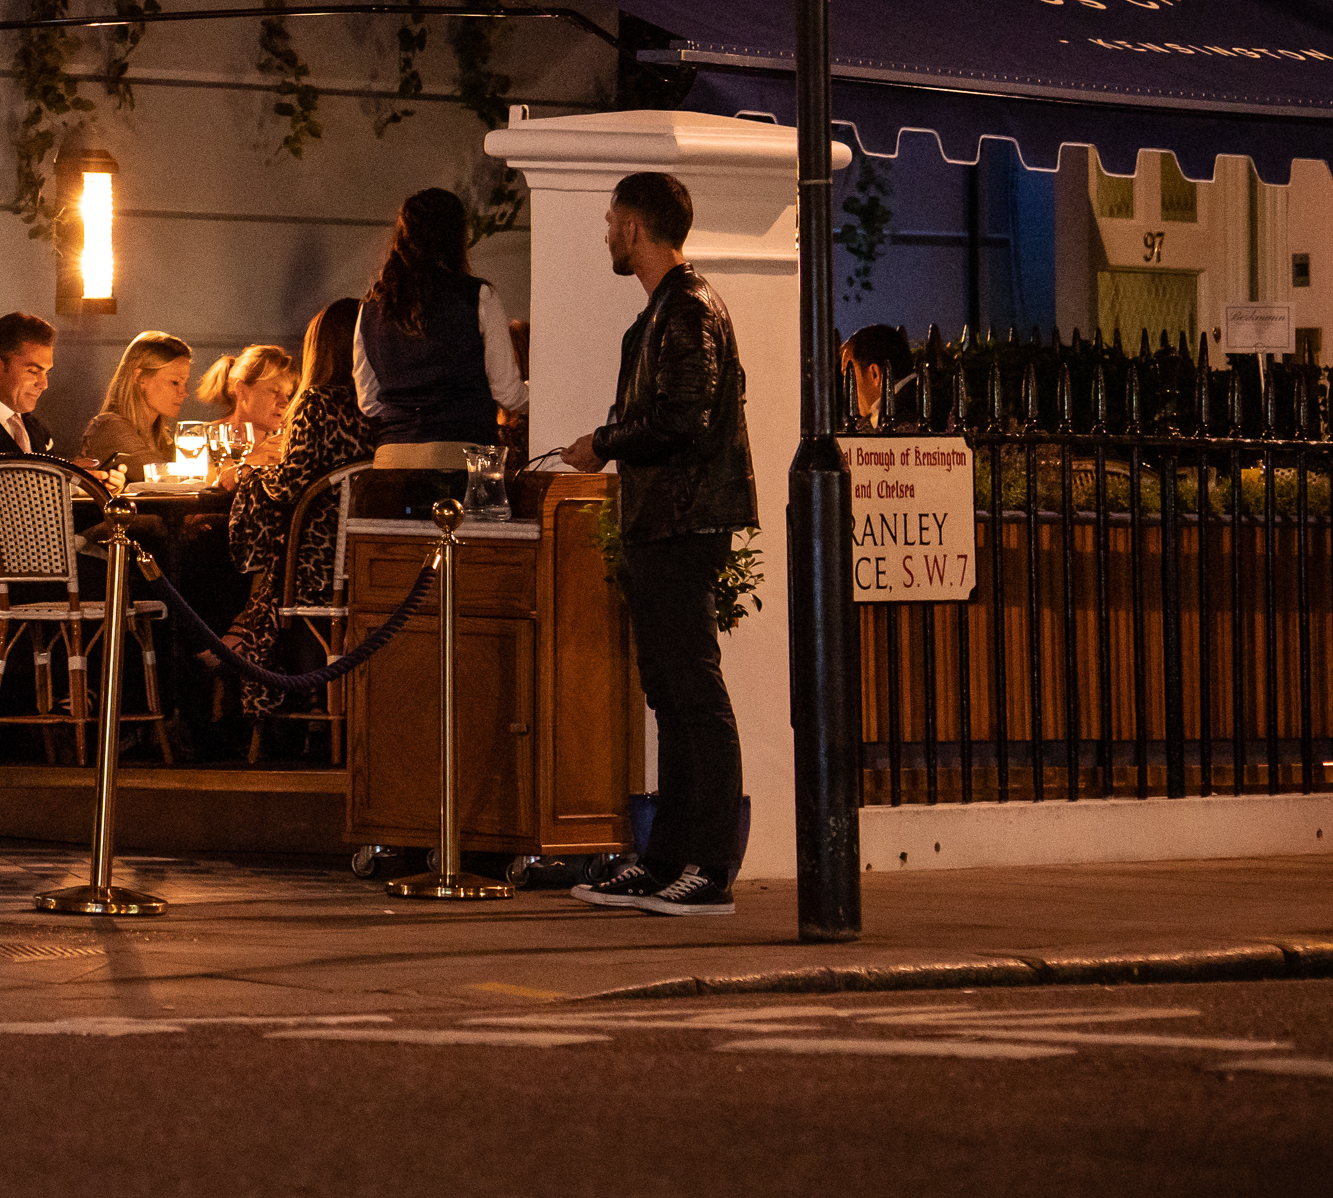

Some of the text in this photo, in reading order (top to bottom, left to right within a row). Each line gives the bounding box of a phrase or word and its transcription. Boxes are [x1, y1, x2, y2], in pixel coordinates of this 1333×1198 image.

[1087, 38, 1333, 60] KENSINGTON
[1143, 231, 1165, 263] 97
[856, 447, 896, 472] Borough
[900, 448, 911, 467] of
[914, 446, 967, 472] Kensington
[854, 480, 915, 499] and Chelsea
[851, 513, 948, 546] RANLEY
[854, 556, 893, 593] CE,
